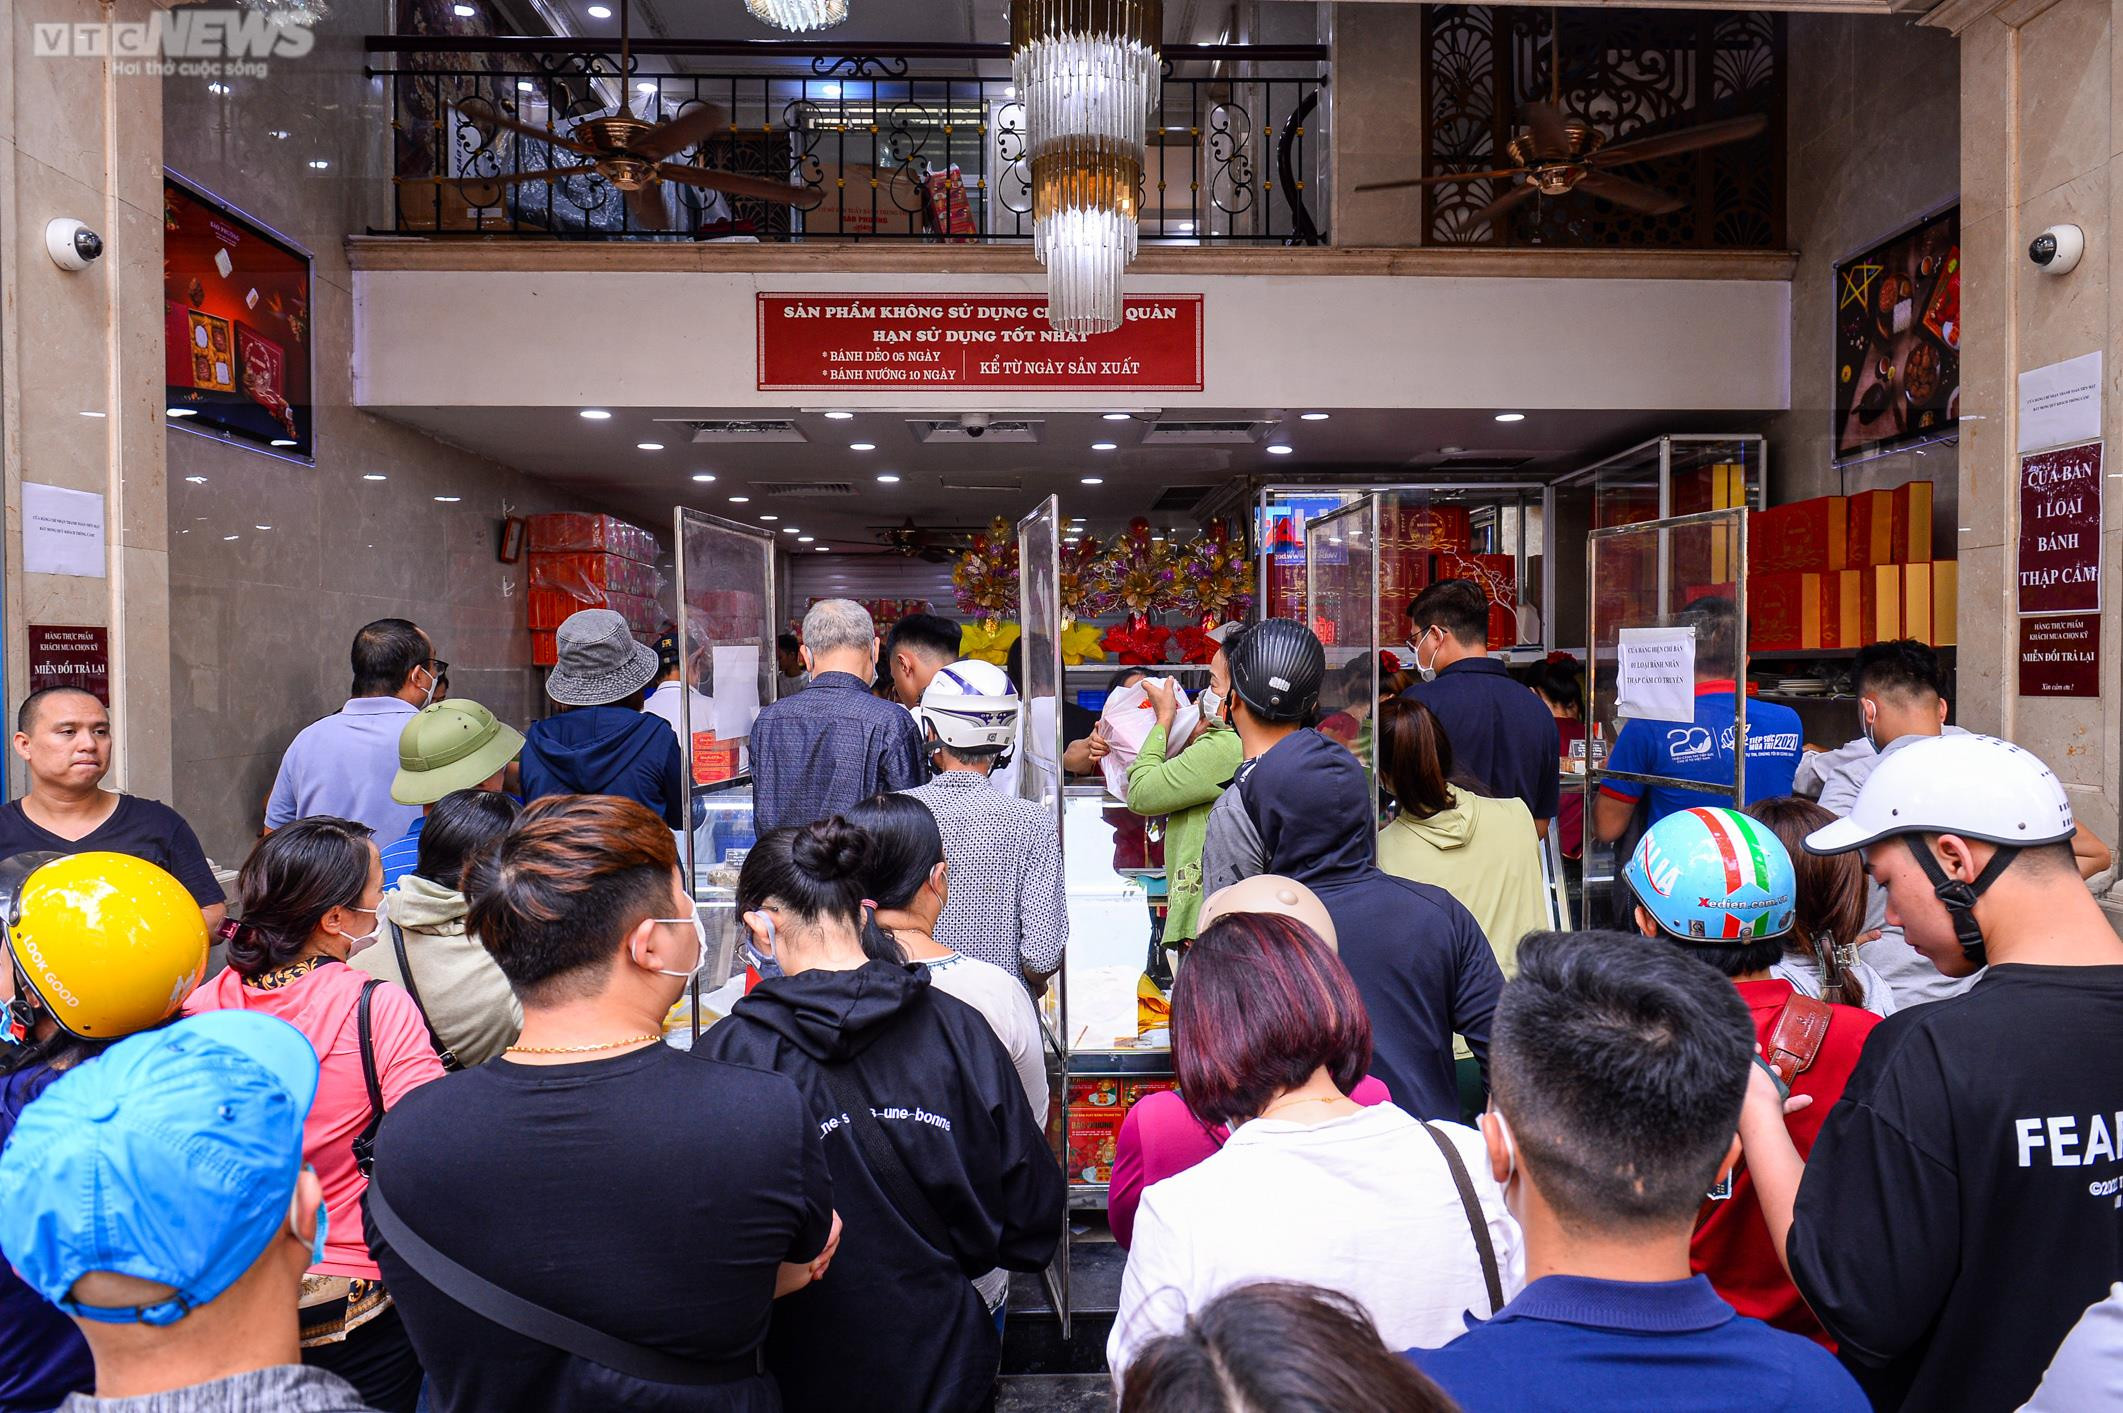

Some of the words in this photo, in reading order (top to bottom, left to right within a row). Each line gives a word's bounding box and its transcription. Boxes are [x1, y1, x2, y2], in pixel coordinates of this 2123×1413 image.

[784, 302, 820, 318] SẢN
[825, 301, 876, 318] PHẨM
[880, 304, 944, 318] KHÔNG
[948, 303, 974, 319] SỬ
[977, 307, 1029, 321] DỤNG
[1125, 304, 1177, 321] QUẢN
[873, 330, 912, 344] HẠN
[916, 326, 941, 342] SỬ
[945, 330, 997, 344] DỤNG
[1001, 326, 1036, 342] TỐT
[830, 348, 863, 362] BÁNH
[866, 347, 890, 362] DẺO
[892, 352, 905, 362] 05
[908, 348, 941, 362] NGÀY
[979, 354, 1000, 374] KỂ
[1003, 358, 1022, 374] TỪ
[1024, 359, 1065, 374] NGÀY
[1068, 357, 1096, 374] SẢN
[1100, 357, 1140, 374] XUẤT
[830, 367, 863, 380] BÁNH
[866, 367, 906, 380] NƯỚNG
[909, 370, 920, 380] 10
[923, 367, 956, 380] NGÀY
[2063, 460, 2093, 481] BÁN
[2046, 498, 2082, 518] LOẠI
[2038, 532, 2079, 552] BÁNH
[2020, 568, 2059, 589] THẬP
[2062, 561, 2098, 584] CẨM
[2034, 622, 2050, 630] HÀNG
[45, 632, 62, 640] HÀNG
[40, 642, 60, 651] KHÁCH
[2022, 649, 2044, 662] MIỄN
[2061, 649, 2078, 661] TRẢ
[2080, 652, 2095, 663] LẠI
[35, 660, 56, 675] MIỄN
[74, 661, 90, 674] TRẢ
[92, 664, 105, 675] LẠI
[1775, 735, 1797, 749] 2021
[23, 935, 49, 972] LOOK
[44, 972, 80, 1008] GOOD
